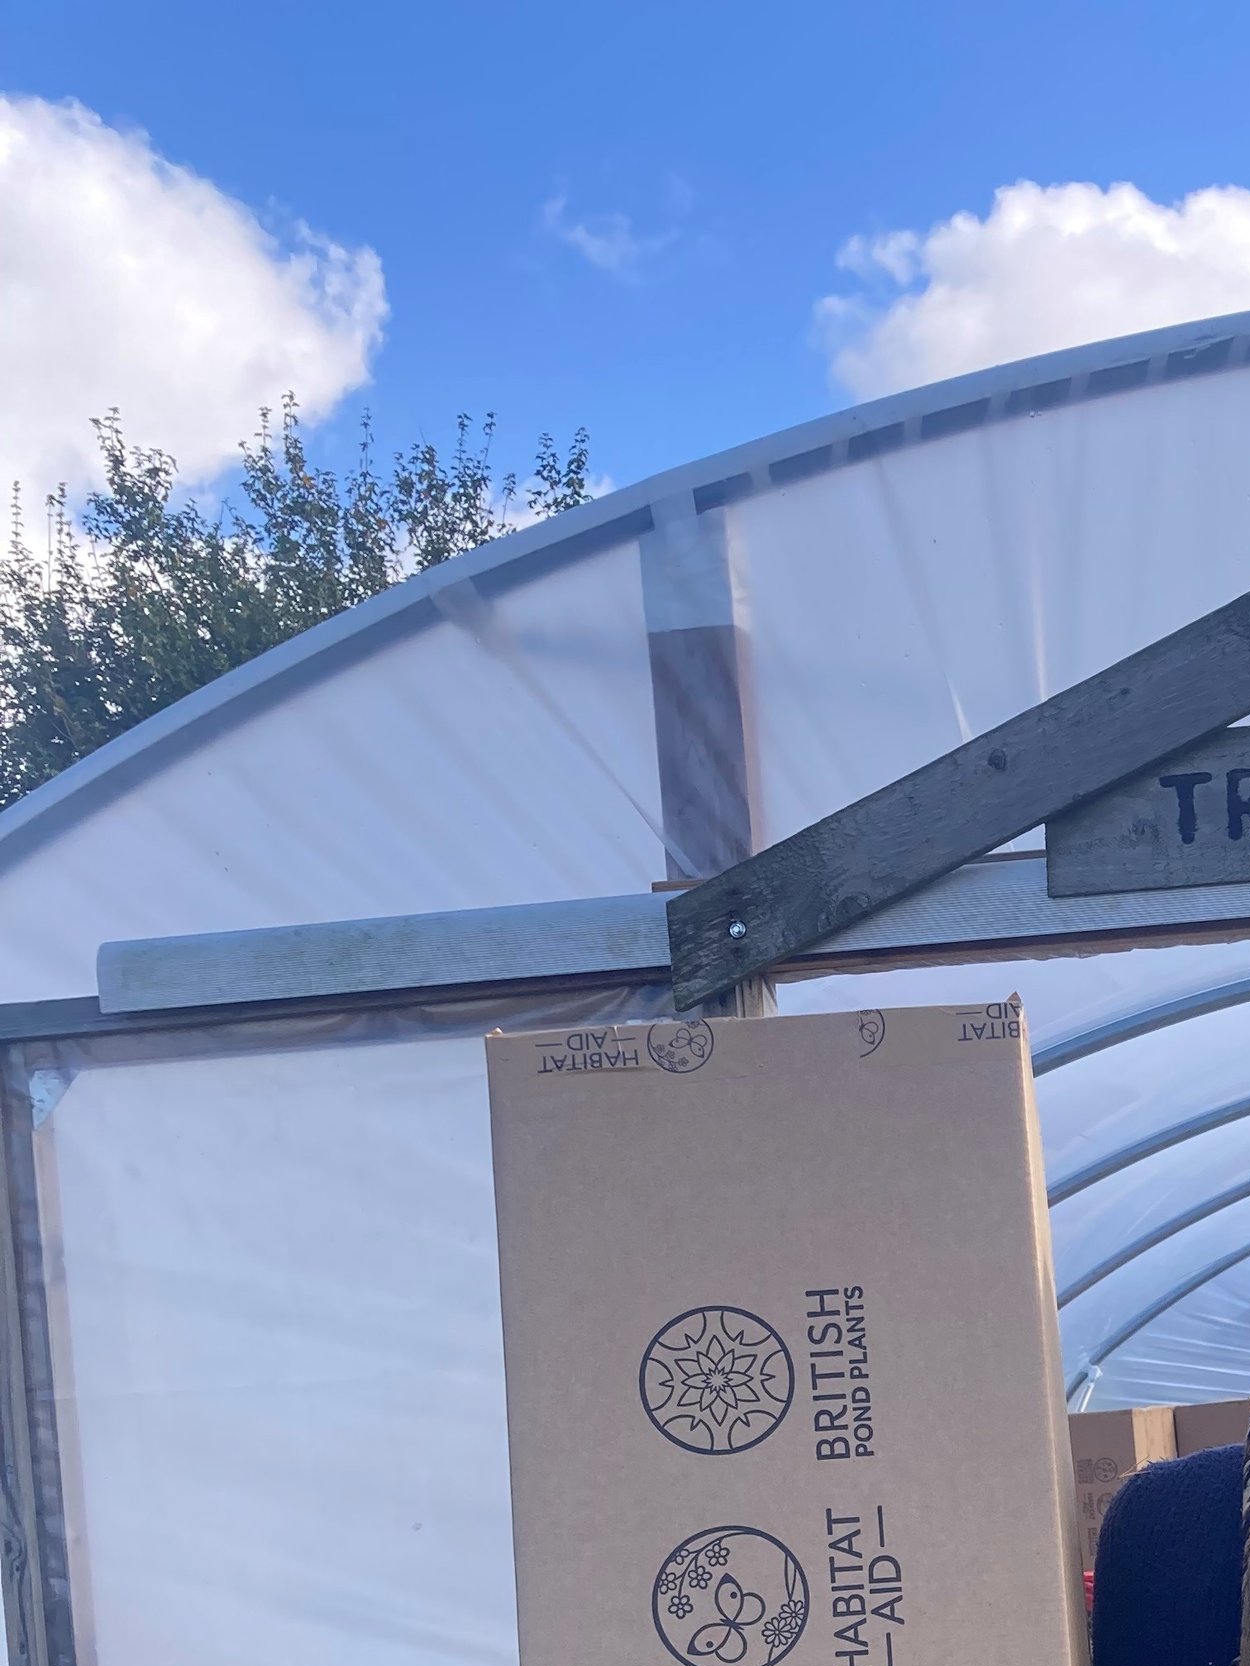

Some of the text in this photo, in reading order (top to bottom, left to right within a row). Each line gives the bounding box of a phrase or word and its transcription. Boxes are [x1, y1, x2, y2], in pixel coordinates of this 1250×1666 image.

[537, 1048, 640, 1074] HABITAT
[566, 1031, 608, 1051] AID
[805, 1288, 851, 1461] BRITISH
[843, 1285, 875, 1457] POND PLANTS
[868, 1554, 906, 1626] AID
